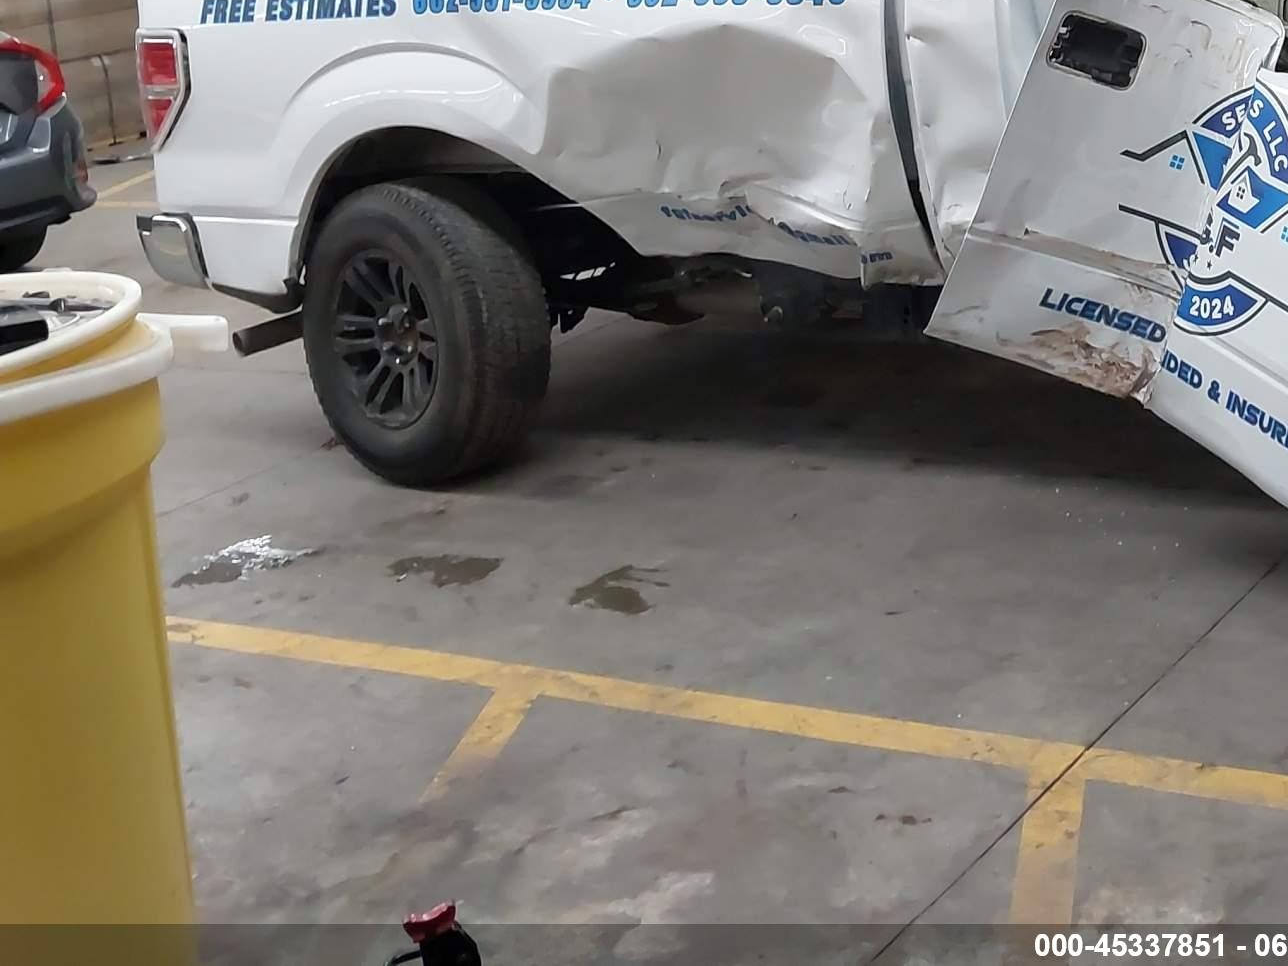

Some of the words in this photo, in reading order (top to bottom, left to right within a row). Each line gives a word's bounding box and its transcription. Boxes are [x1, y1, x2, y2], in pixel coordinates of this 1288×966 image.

[1262, 120, 1288, 172] LLC
[1038, 287, 1167, 343] LICENSED
[1189, 295, 1235, 320] 2024
[1207, 380, 1222, 403] &
